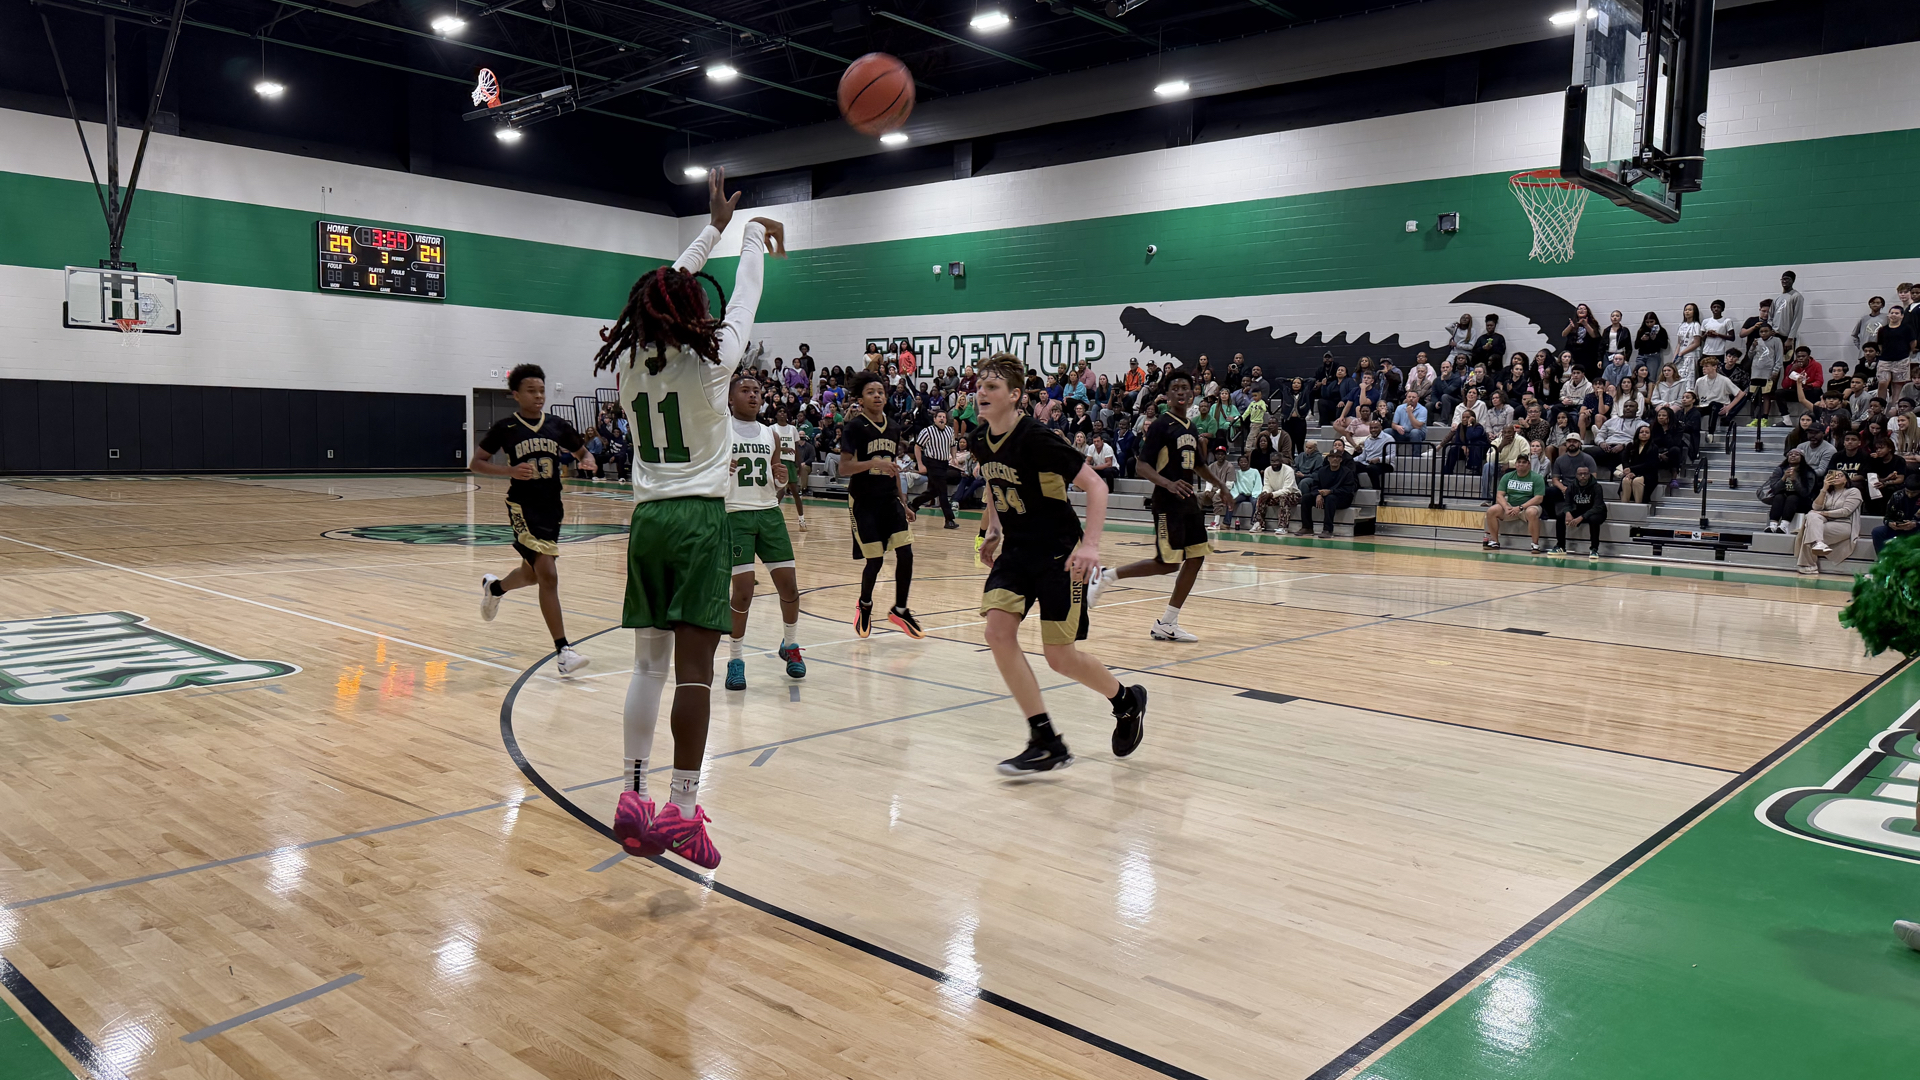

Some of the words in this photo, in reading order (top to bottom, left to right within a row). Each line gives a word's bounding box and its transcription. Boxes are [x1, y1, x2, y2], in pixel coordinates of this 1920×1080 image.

[326, 223, 349, 234] HOME
[329, 234, 352, 254] 29
[372, 229, 407, 250] 3:59
[415, 234, 441, 245] VISITOR
[381, 251, 389, 264] 3
[420, 244, 441, 264] 24
[368, 266, 386, 274] PLAYER
[1038, 330, 1106, 377] UP
[631, 391, 692, 463] 11
[514, 437, 560, 459] BRISCOE
[737, 456, 768, 487] 23
[1507, 479, 1534, 491] GATORS
[991, 484, 1027, 515] 34
